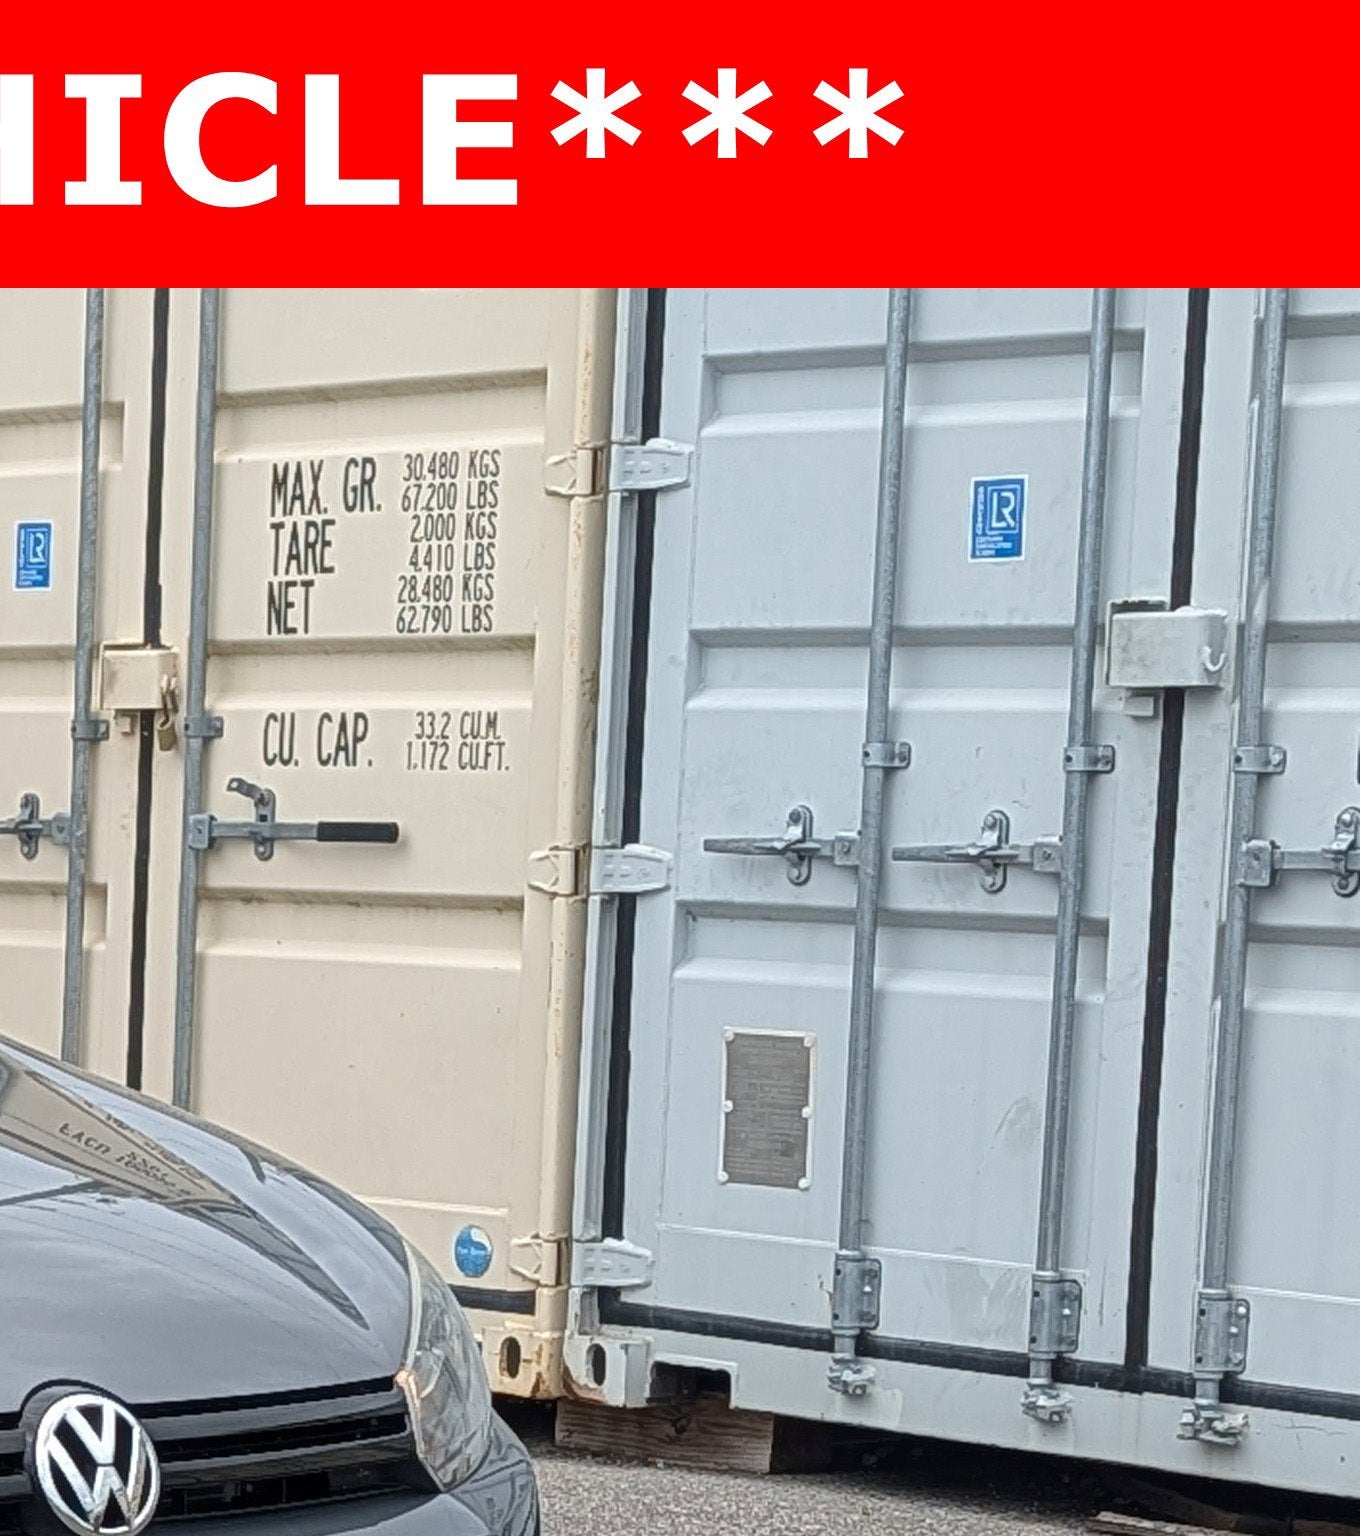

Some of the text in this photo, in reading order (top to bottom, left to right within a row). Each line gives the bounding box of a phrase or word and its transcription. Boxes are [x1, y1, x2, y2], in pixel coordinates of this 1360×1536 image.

[468, 449, 501, 479] KGS
[270, 457, 382, 517] MAX. GR.
[466, 480, 499, 510] LBS
[464, 511, 498, 541] KGS
[270, 519, 336, 576] TARE
[464, 542, 495, 571] LBS
[462, 573, 494, 602] KGS
[266, 579, 315, 635] NET
[461, 604, 494, 633] LBS
[263, 712, 373, 766] CU. CAP.
[414, 711, 451, 740] 33.2
